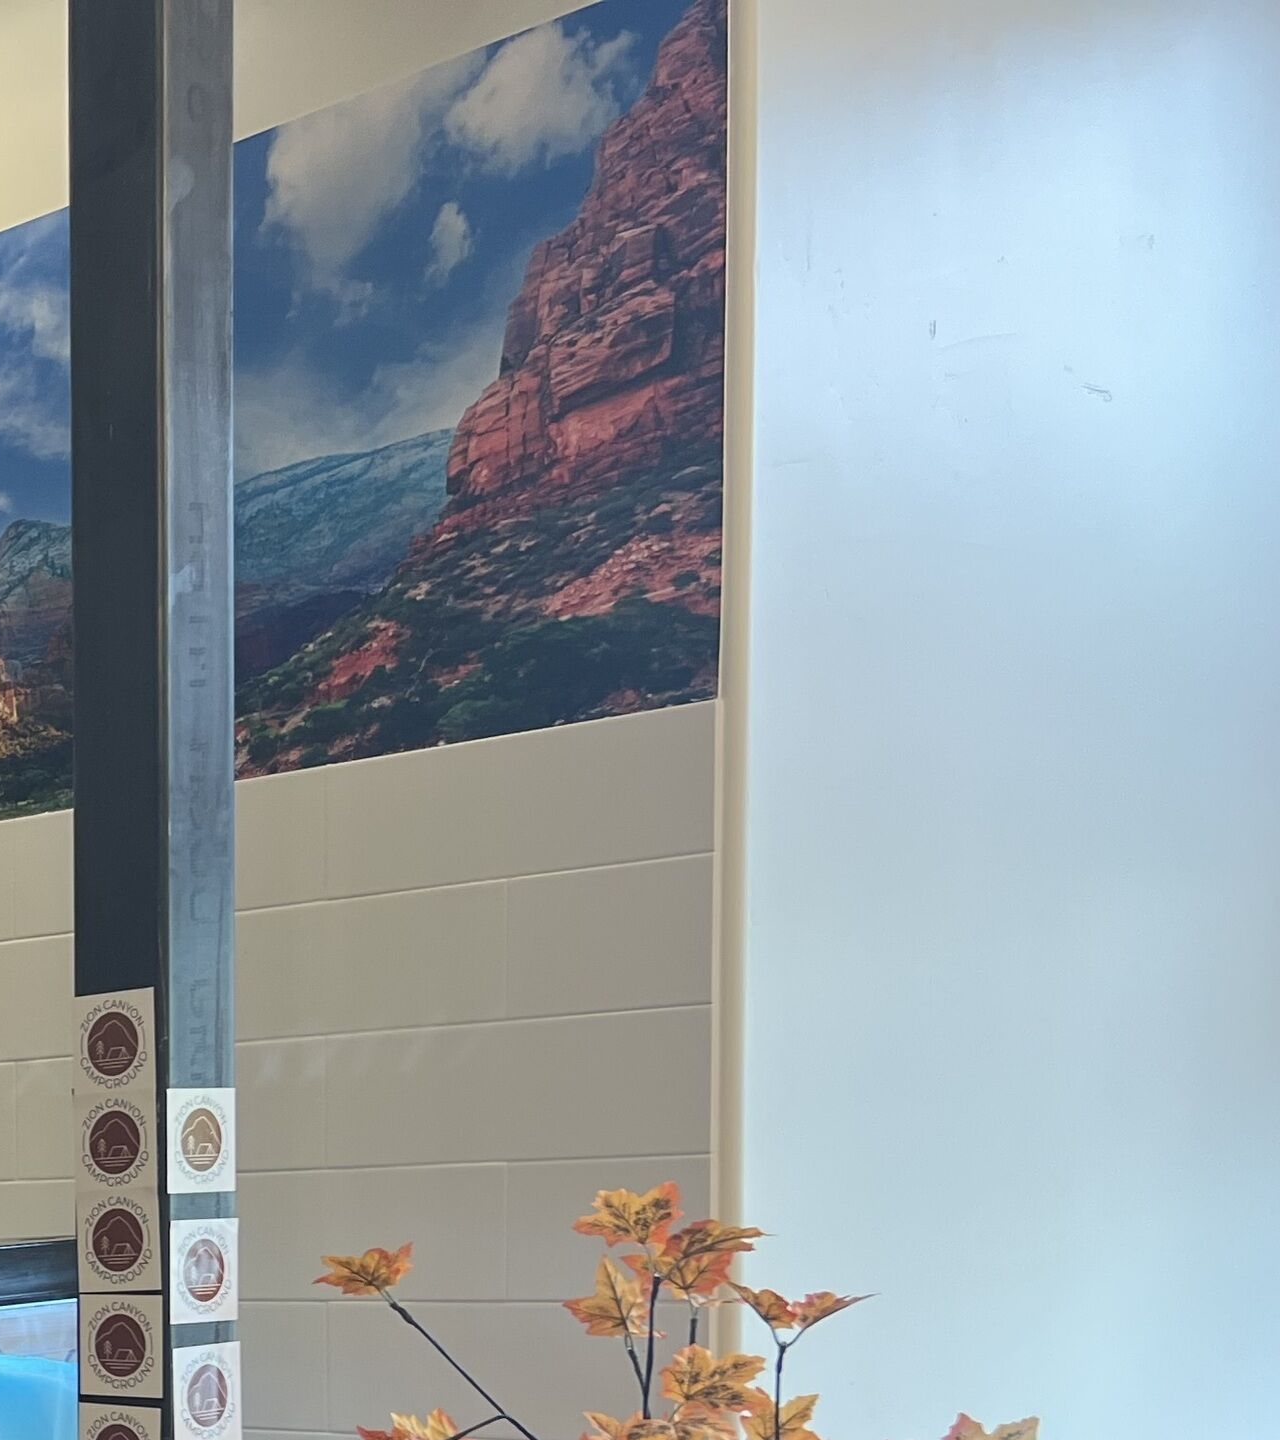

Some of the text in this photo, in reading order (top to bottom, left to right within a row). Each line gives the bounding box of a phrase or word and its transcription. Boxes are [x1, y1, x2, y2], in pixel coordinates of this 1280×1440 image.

[80, 999, 145, 1033] ZION CANYON
[80, 1051, 148, 1089] CAMPGROUND
[82, 1098, 147, 1131] ZION CANYON
[82, 1150, 149, 1188] CAMPGROUND
[84, 1196, 149, 1228] ZION CANYON
[85, 1248, 152, 1285] CAMPGROUND
[88, 1301, 153, 1333] ZION CANYON
[88, 1354, 155, 1390] CAMPGROUND
[86, 1414, 109, 1440] ZION
